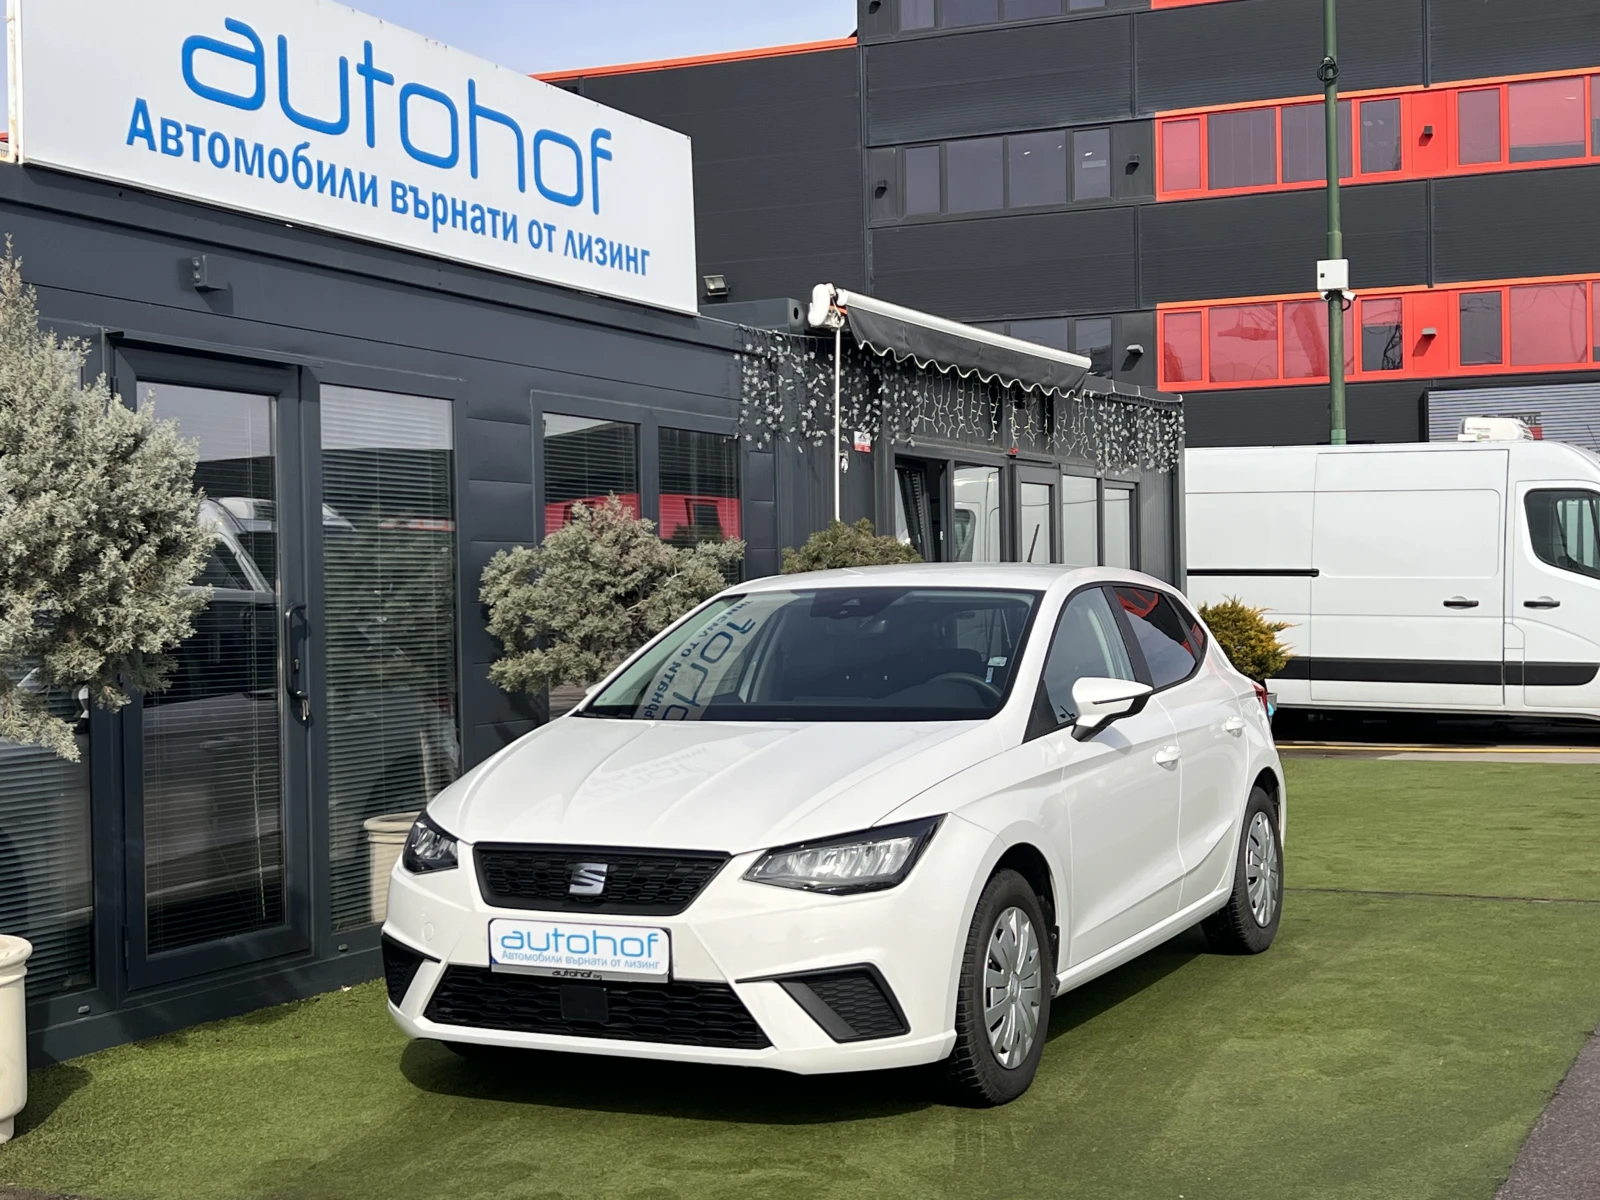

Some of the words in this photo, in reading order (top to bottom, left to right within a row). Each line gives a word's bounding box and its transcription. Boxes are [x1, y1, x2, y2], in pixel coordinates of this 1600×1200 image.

[180, 17, 613, 215] autohof
[126, 97, 378, 207] Автомобили
[390, 179, 519, 244] върнати
[527, 219, 557, 253] от
[563, 229, 650, 276] лизинг
[501, 928, 659, 958] autohof
[502, 950, 562, 964] Автомобили
[565, 957, 607, 968] върнати
[611, 959, 621, 967] от
[624, 959, 660, 970] лизинг
